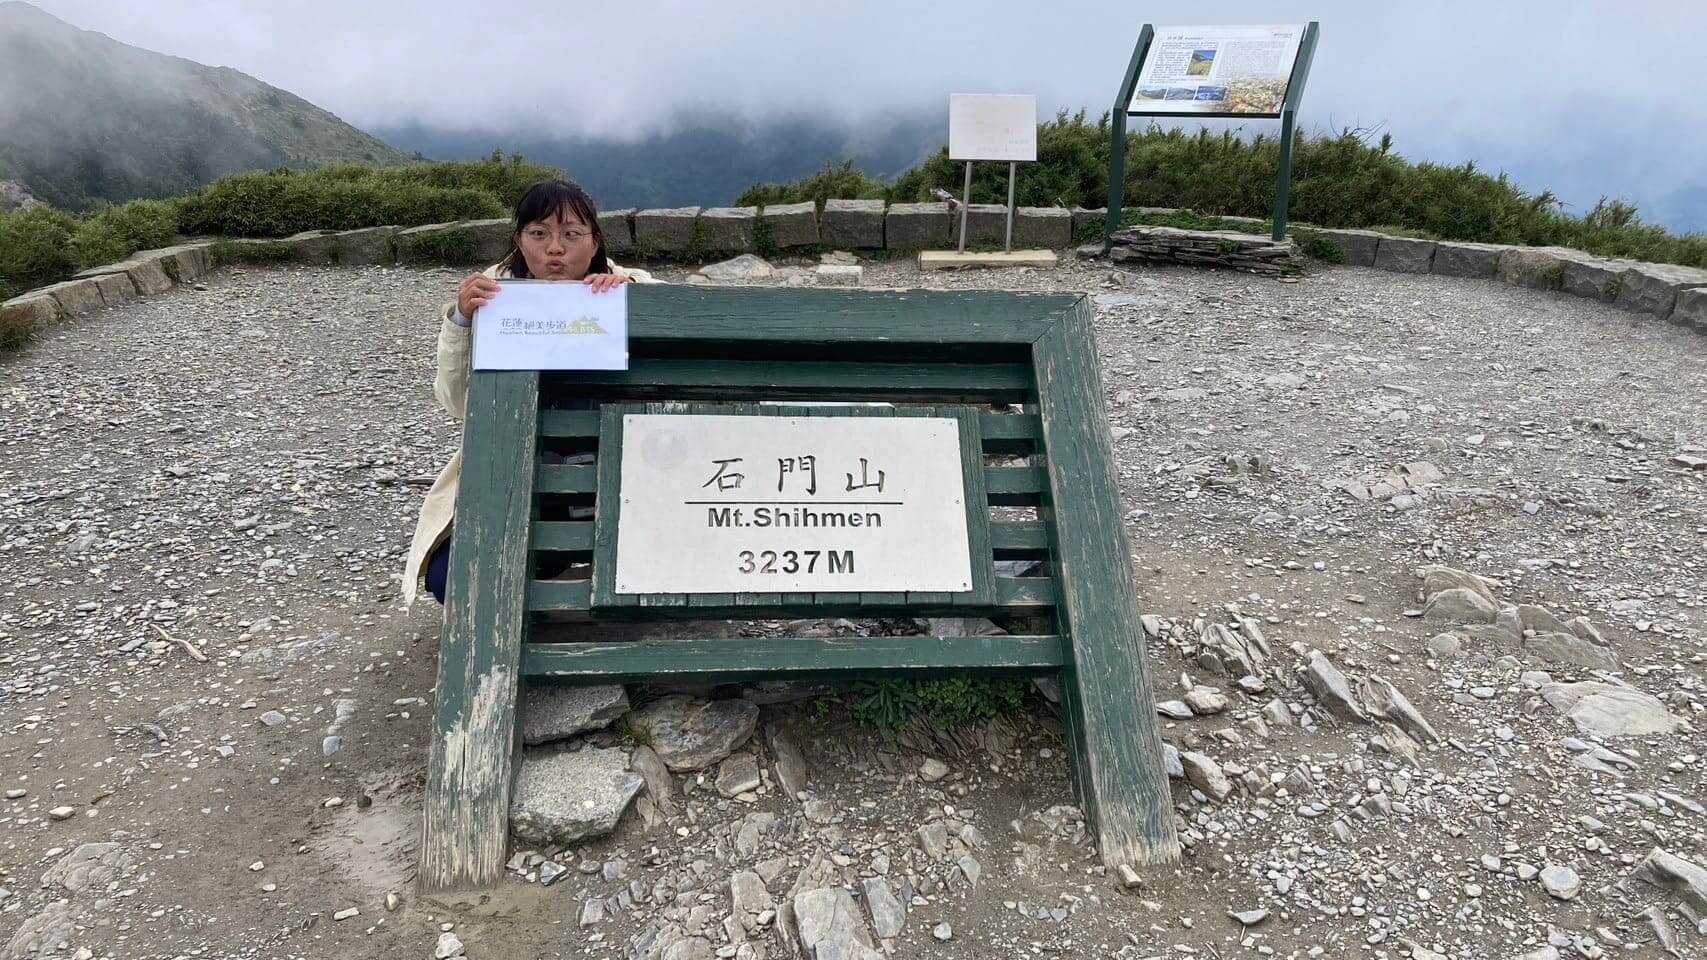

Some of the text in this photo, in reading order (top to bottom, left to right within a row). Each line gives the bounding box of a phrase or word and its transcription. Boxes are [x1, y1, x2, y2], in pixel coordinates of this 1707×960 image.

[701, 454, 886, 496] 石門山
[708, 507, 882, 528] Mt.Shihmen
[738, 550, 855, 574] 3237M
